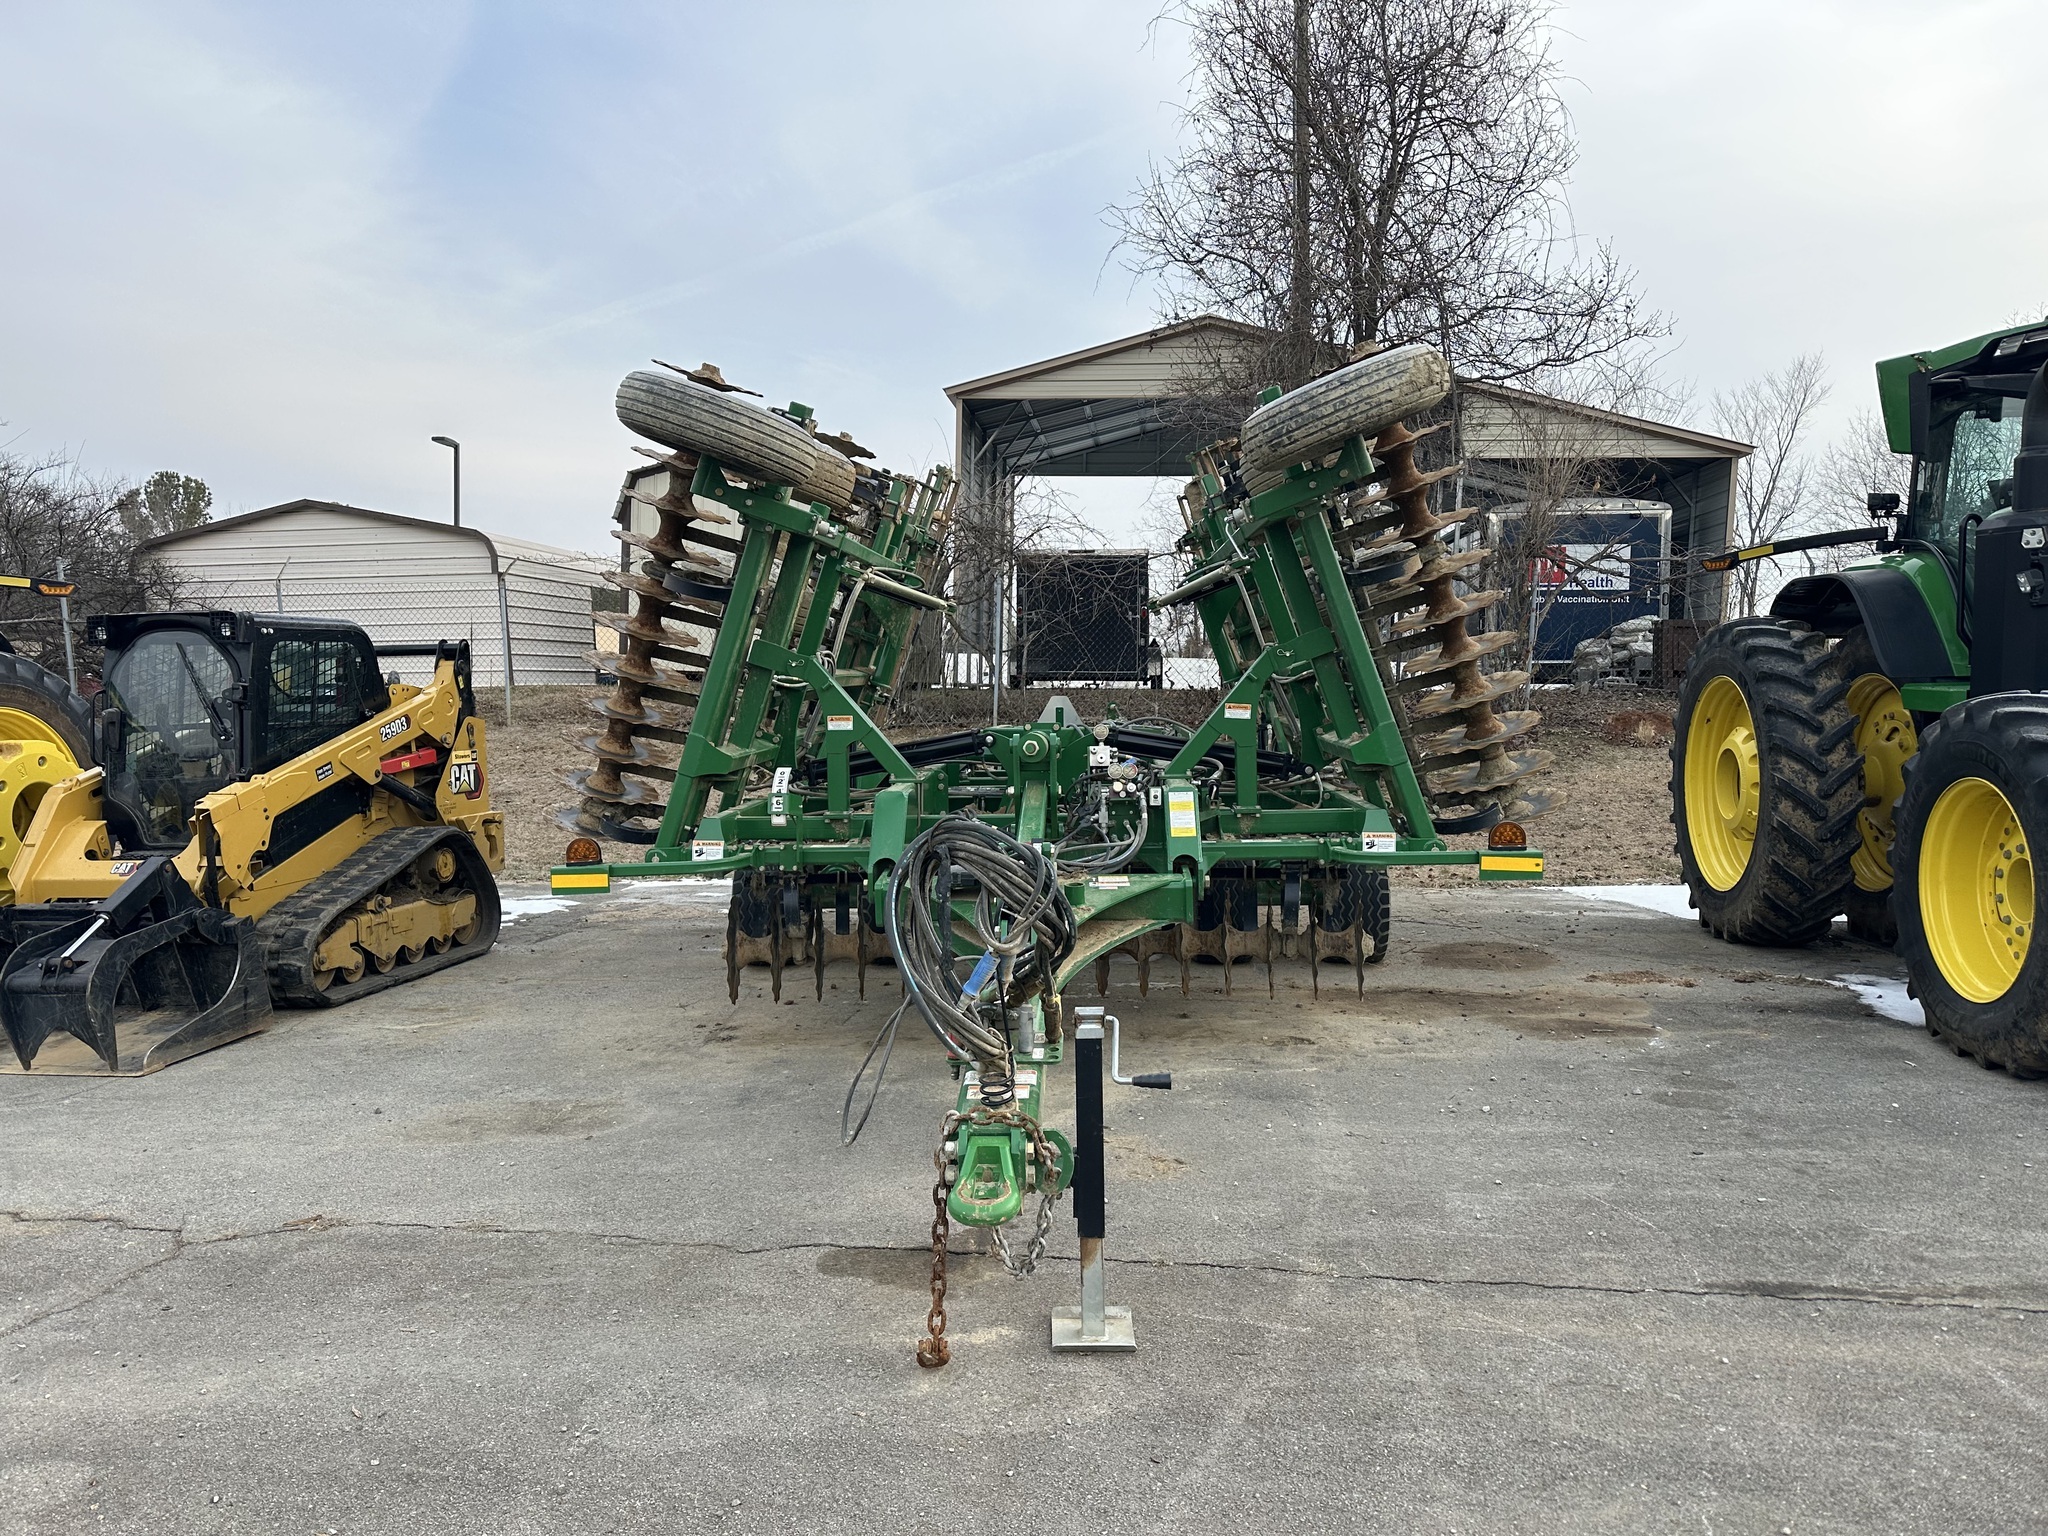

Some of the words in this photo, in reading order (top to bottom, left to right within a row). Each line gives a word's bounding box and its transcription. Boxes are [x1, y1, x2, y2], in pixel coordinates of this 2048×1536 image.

[1557, 595, 1608, 603] Vaccination
[380, 716, 408, 742] 259D3
[450, 763, 477, 795] CAT
[110, 862, 134, 874] CAT
